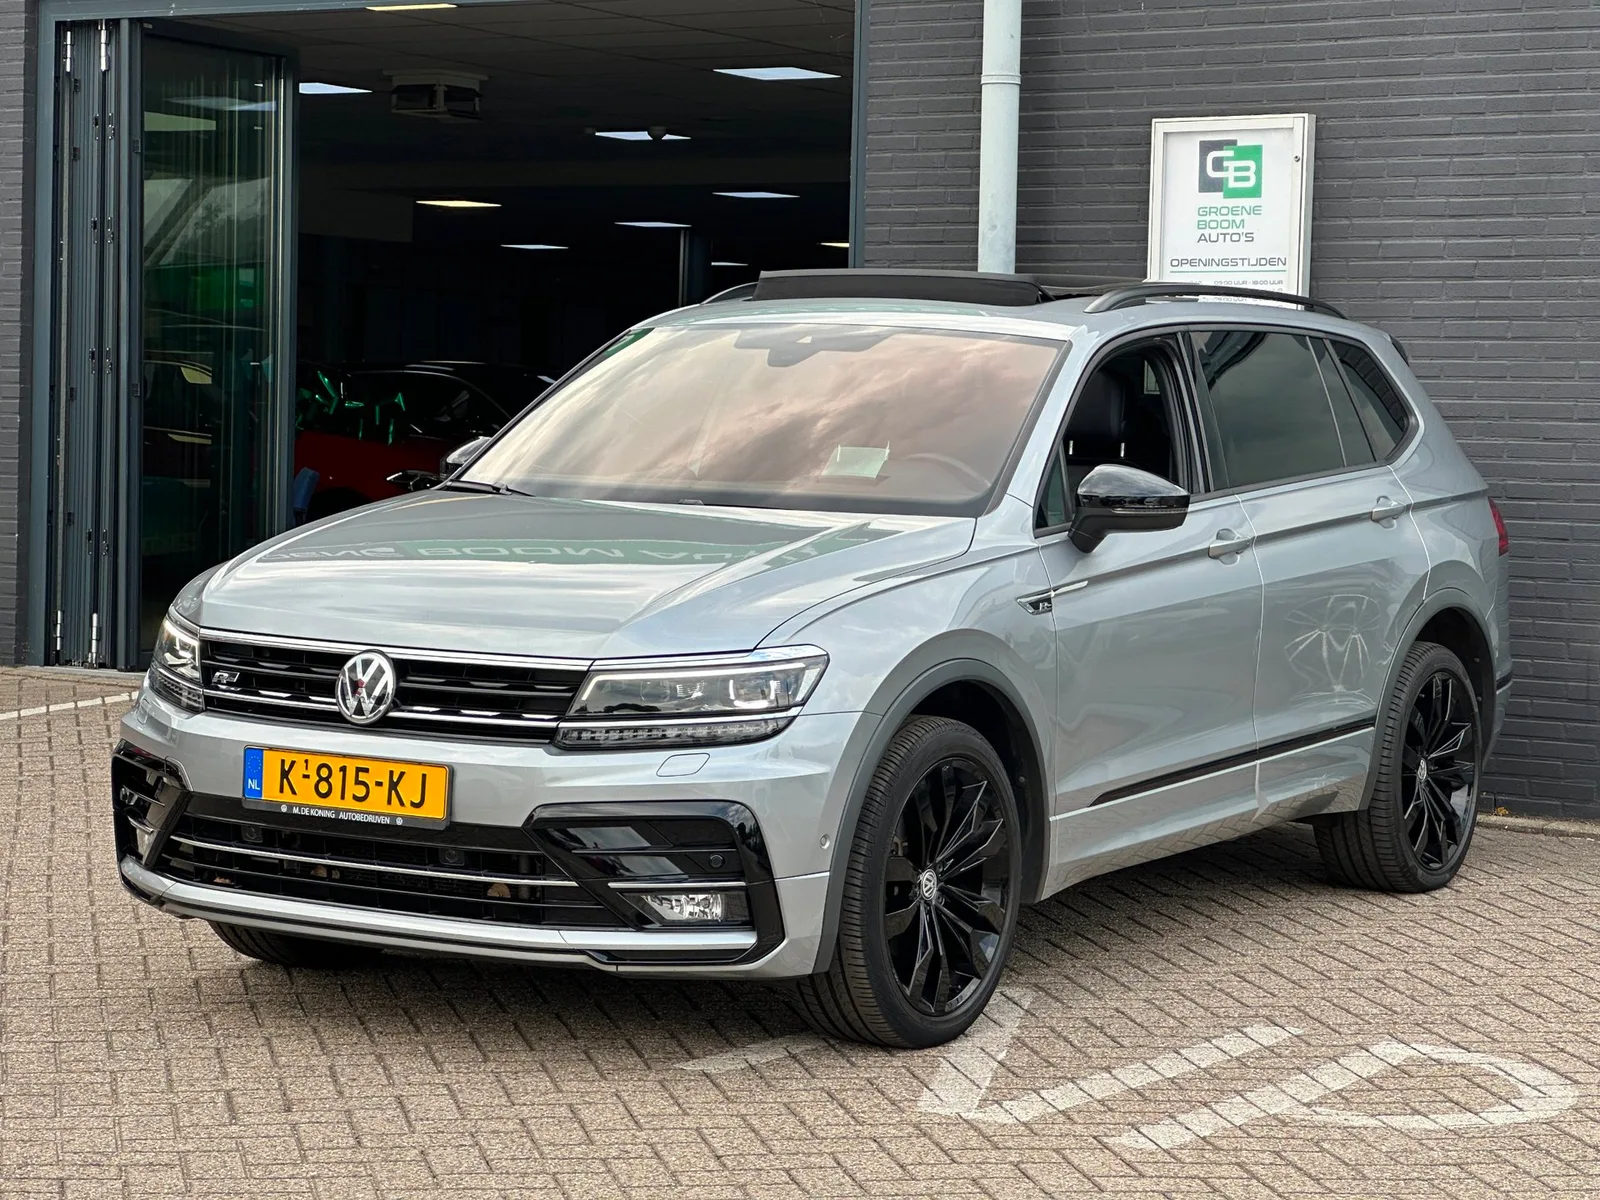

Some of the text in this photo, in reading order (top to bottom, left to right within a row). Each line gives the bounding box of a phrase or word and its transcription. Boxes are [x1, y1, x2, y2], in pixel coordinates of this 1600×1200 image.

[1197, 205, 1263, 217] GROENE
[1197, 219, 1245, 230] BOOM
[1197, 231, 1255, 243] AUTO'S
[1170, 257, 1287, 268] OPENINGSTIJDEN
[247, 777, 261, 791] NL
[301, 807, 309, 815] DE
[310, 808, 336, 819] KONING
[339, 811, 391, 825] AUTOBEDRIJVEN
